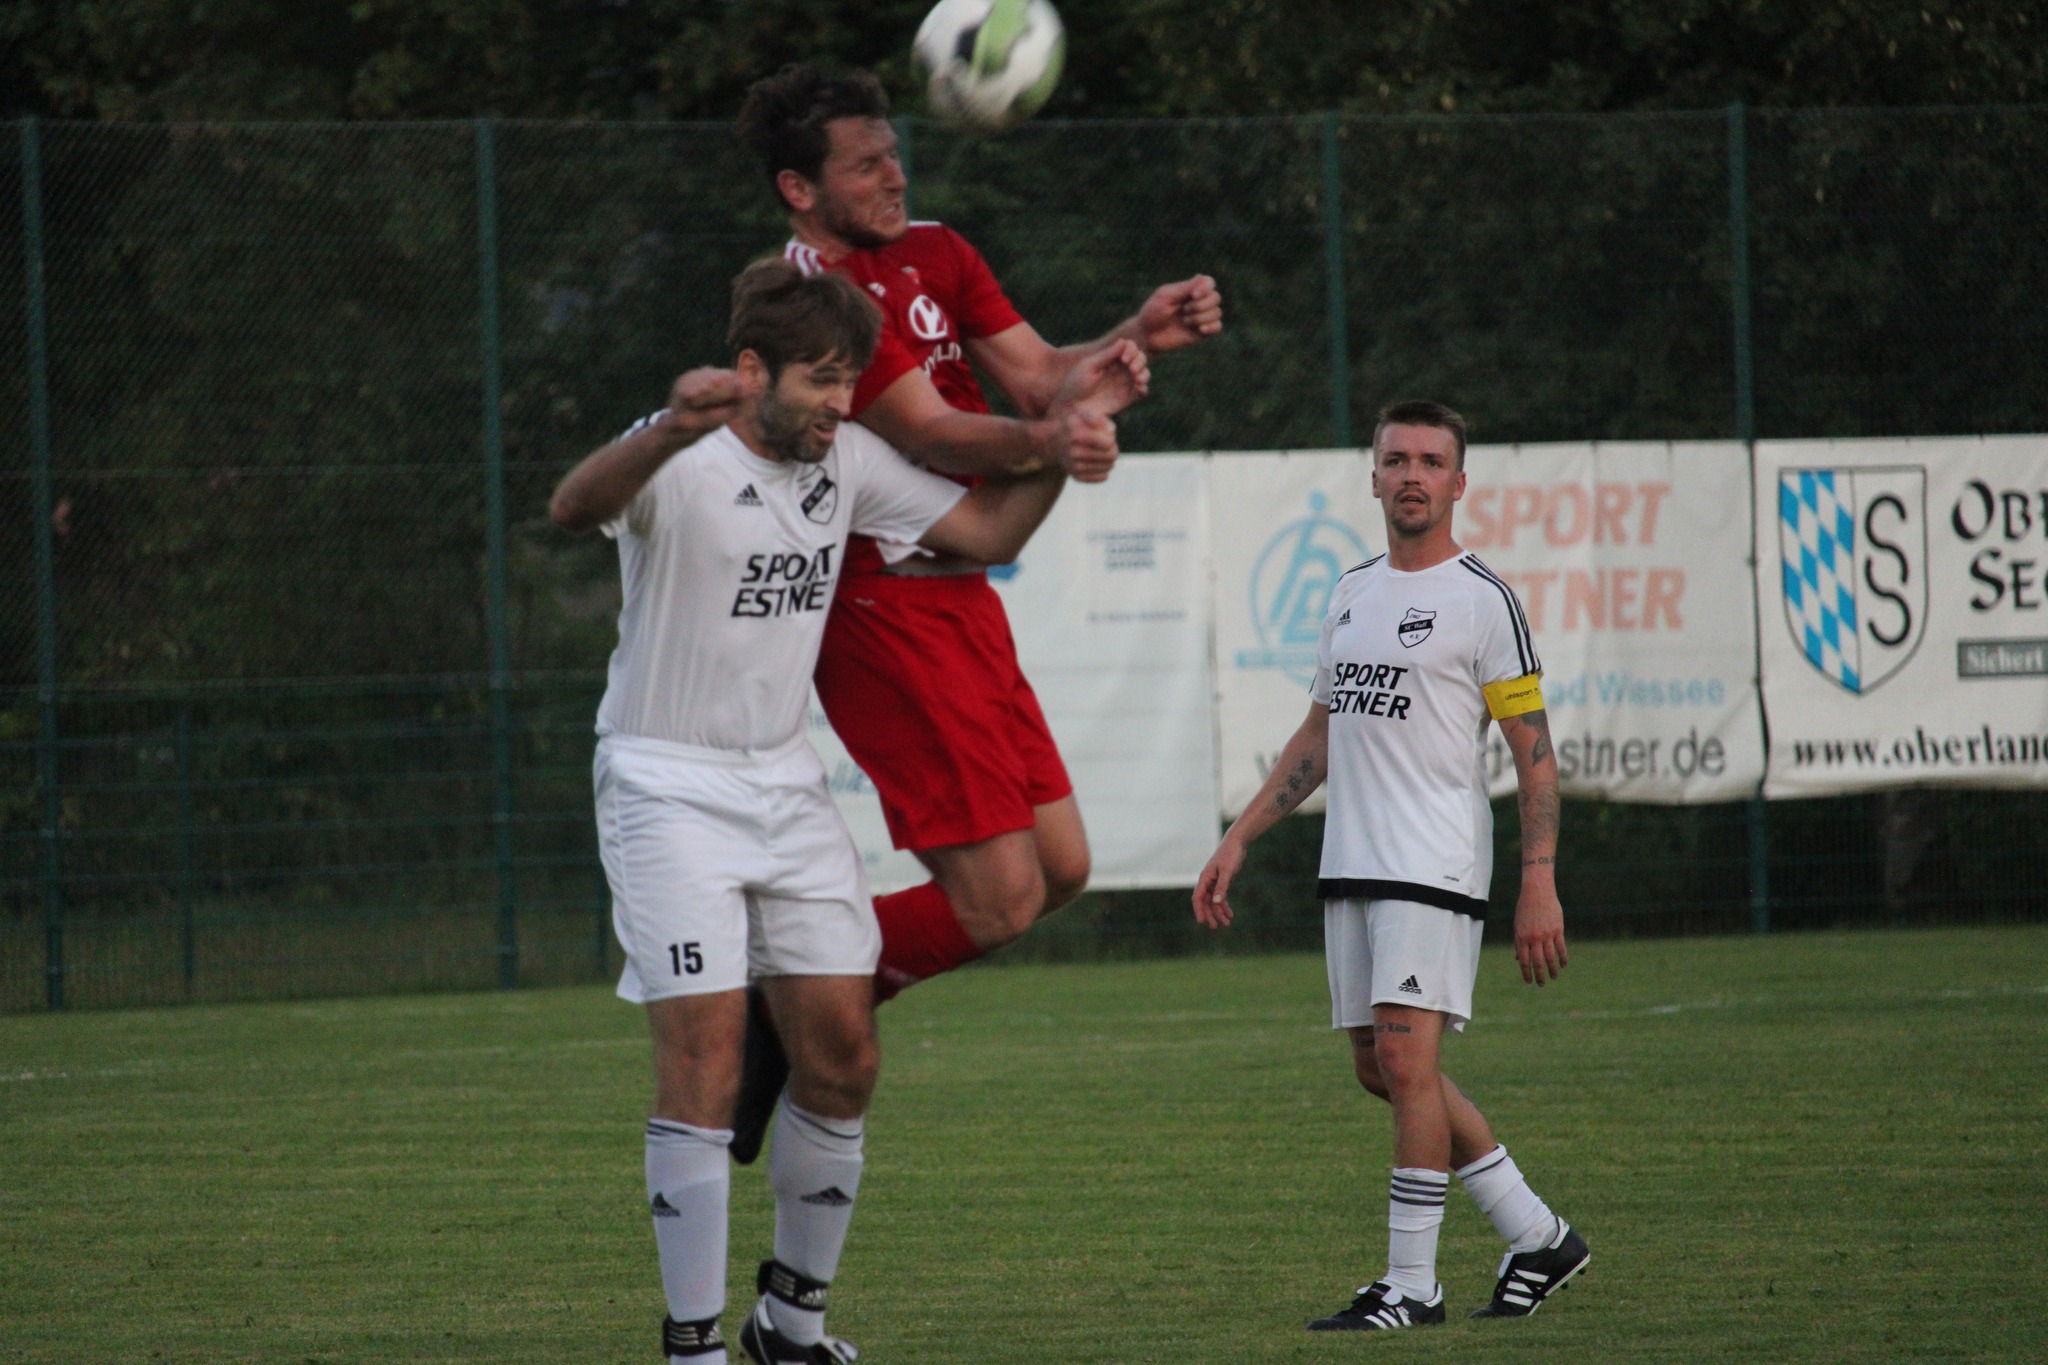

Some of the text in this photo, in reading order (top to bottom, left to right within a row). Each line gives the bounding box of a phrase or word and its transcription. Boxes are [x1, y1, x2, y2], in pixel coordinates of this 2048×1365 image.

[1461, 480, 1673, 548] SPORT
[731, 581, 836, 618] ESTNE
[1502, 566, 1687, 633] TNER
[1334, 662, 1409, 690] SPORT
[668, 942, 703, 976] 15
